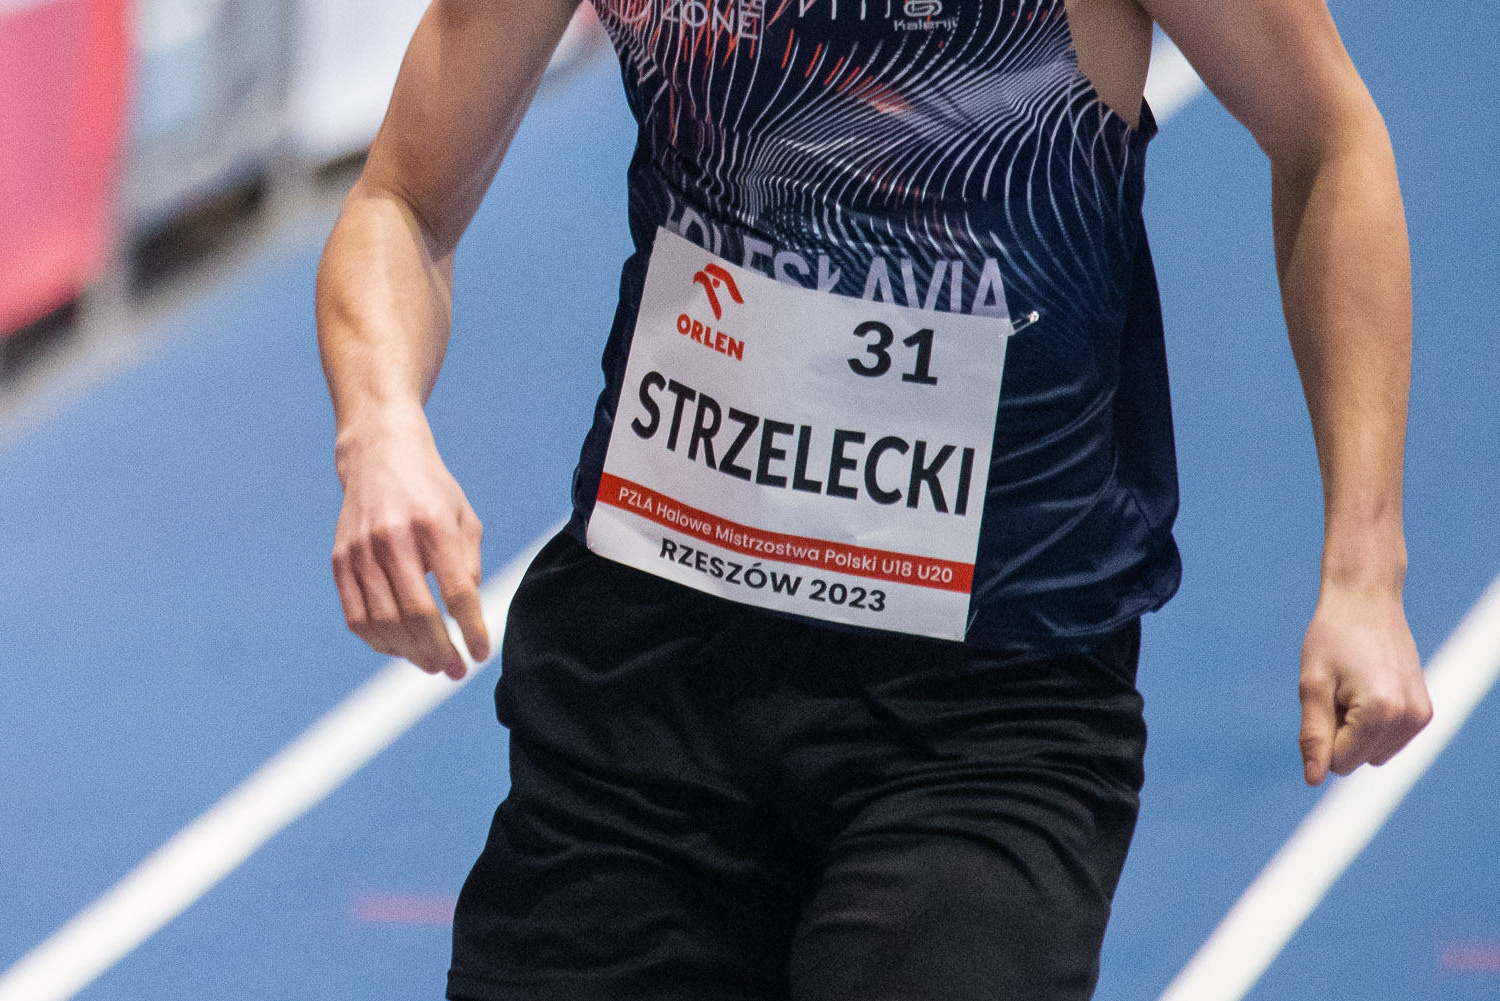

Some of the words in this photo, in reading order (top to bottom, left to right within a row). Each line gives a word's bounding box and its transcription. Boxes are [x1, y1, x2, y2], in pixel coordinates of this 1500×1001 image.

[676, 314, 745, 362] ORLEN
[847, 320, 938, 387] 31
[630, 371, 976, 517] STRZELECKI
[618, 486, 653, 513] PZLA
[656, 502, 712, 535] Halowe
[715, 525, 820, 561] Mistrzostwa
[824, 549, 876, 572] Polski
[881, 558, 912, 578] U18
[917, 564, 953, 583] U20
[659, 537, 802, 596] RZESZÓW
[808, 579, 887, 612] 2023
